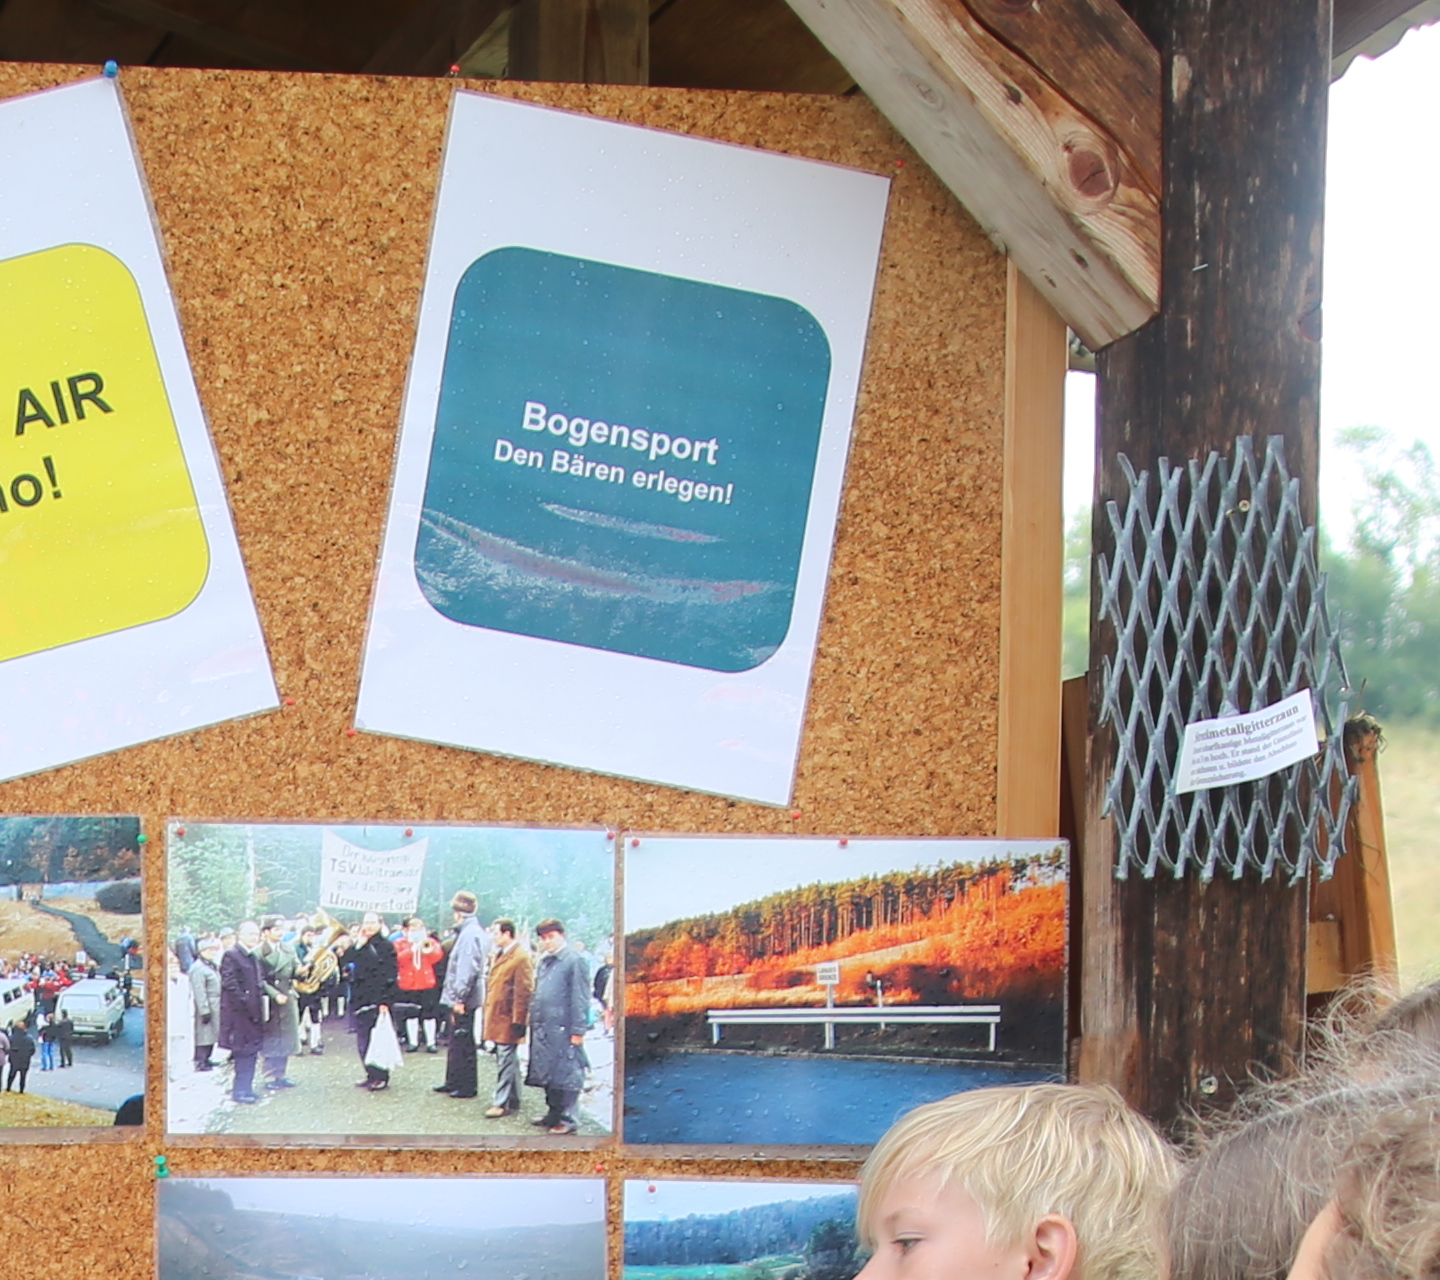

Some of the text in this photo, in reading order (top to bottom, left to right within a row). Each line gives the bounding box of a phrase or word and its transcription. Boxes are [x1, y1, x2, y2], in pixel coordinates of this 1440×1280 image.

[12, 371, 115, 438] AIR
[521, 400, 719, 467] Bogensport
[493, 438, 734, 508] Den Bären erlegen!
[330, 858, 357, 874] TSV
